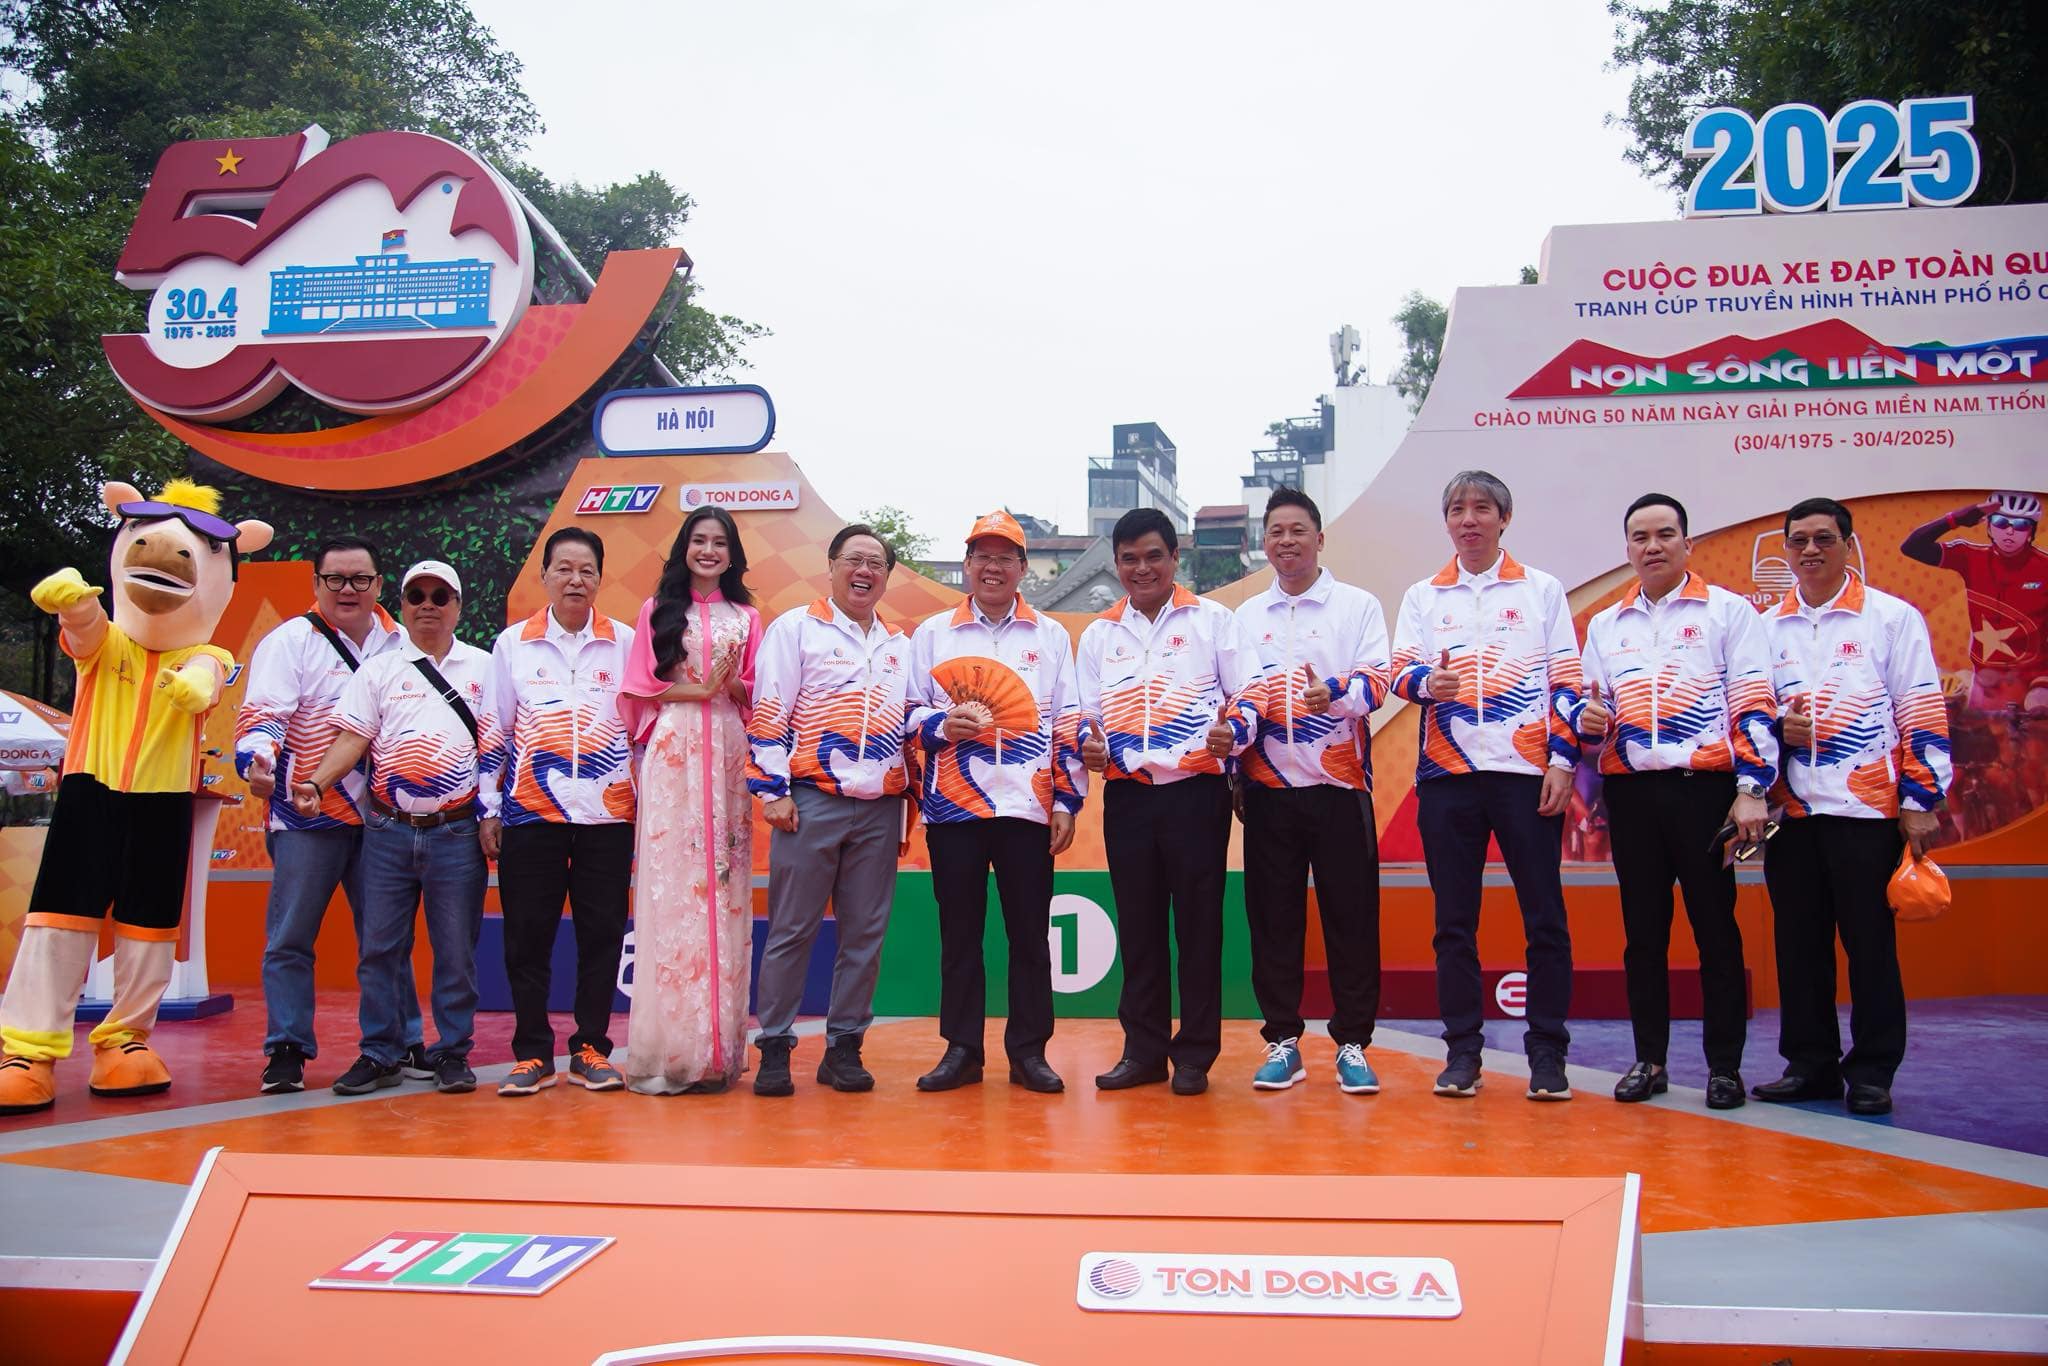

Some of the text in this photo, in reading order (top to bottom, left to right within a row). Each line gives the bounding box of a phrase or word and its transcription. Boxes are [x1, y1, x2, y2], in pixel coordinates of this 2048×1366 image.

[1688, 98, 1978, 214] 2025
[1603, 261, 1697, 296] CUỘC
[1708, 264, 1772, 287] ĐUA
[1783, 261, 1820, 284] XE
[1831, 258, 1896, 288] ĐẠP
[1905, 249, 1994, 279] TOÀN
[166, 287, 238, 320] 30.4
[1575, 300, 1647, 317] TRANH
[1655, 295, 1698, 314] CÚP
[1706, 289, 1793, 312] TRUYỀN
[1802, 289, 1853, 309] HÌNH
[1861, 286, 1936, 306] THÀNH
[1945, 280, 1992, 303] PHỐ
[1999, 279, 2032, 301] HỒ
[164, 326, 194, 339] 1975
[206, 325, 236, 338] 2025
[1570, 362, 1668, 389] NON
[1687, 353, 1809, 387] SÔNG
[1936, 345, 2038, 381] MỘT
[657, 406, 715, 433] HÀ NỘI
[1474, 408, 1531, 427] CHÀO
[1537, 406, 1597, 425] MỪNG
[1603, 408, 1625, 424] 50
[1631, 404, 1675, 422] NĂM
[1683, 401, 1740, 421] NGÀY
[1747, 398, 1787, 419] GIẢI
[1795, 398, 1868, 417] PHÓNG
[1875, 393, 1926, 416] MIỀN
[1735, 433, 1833, 454] (30/4/1975
[1853, 429, 1955, 448] 30/4/2025)
[580, 488, 657, 510] HTV
[705, 488, 794, 503] TON DONG A
[1, 749, 51, 760] DONG A
[1051, 912, 1078, 975] 1
[338, 1237, 589, 1279] HTV
[1155, 1267, 1449, 1297] TON DONG A
